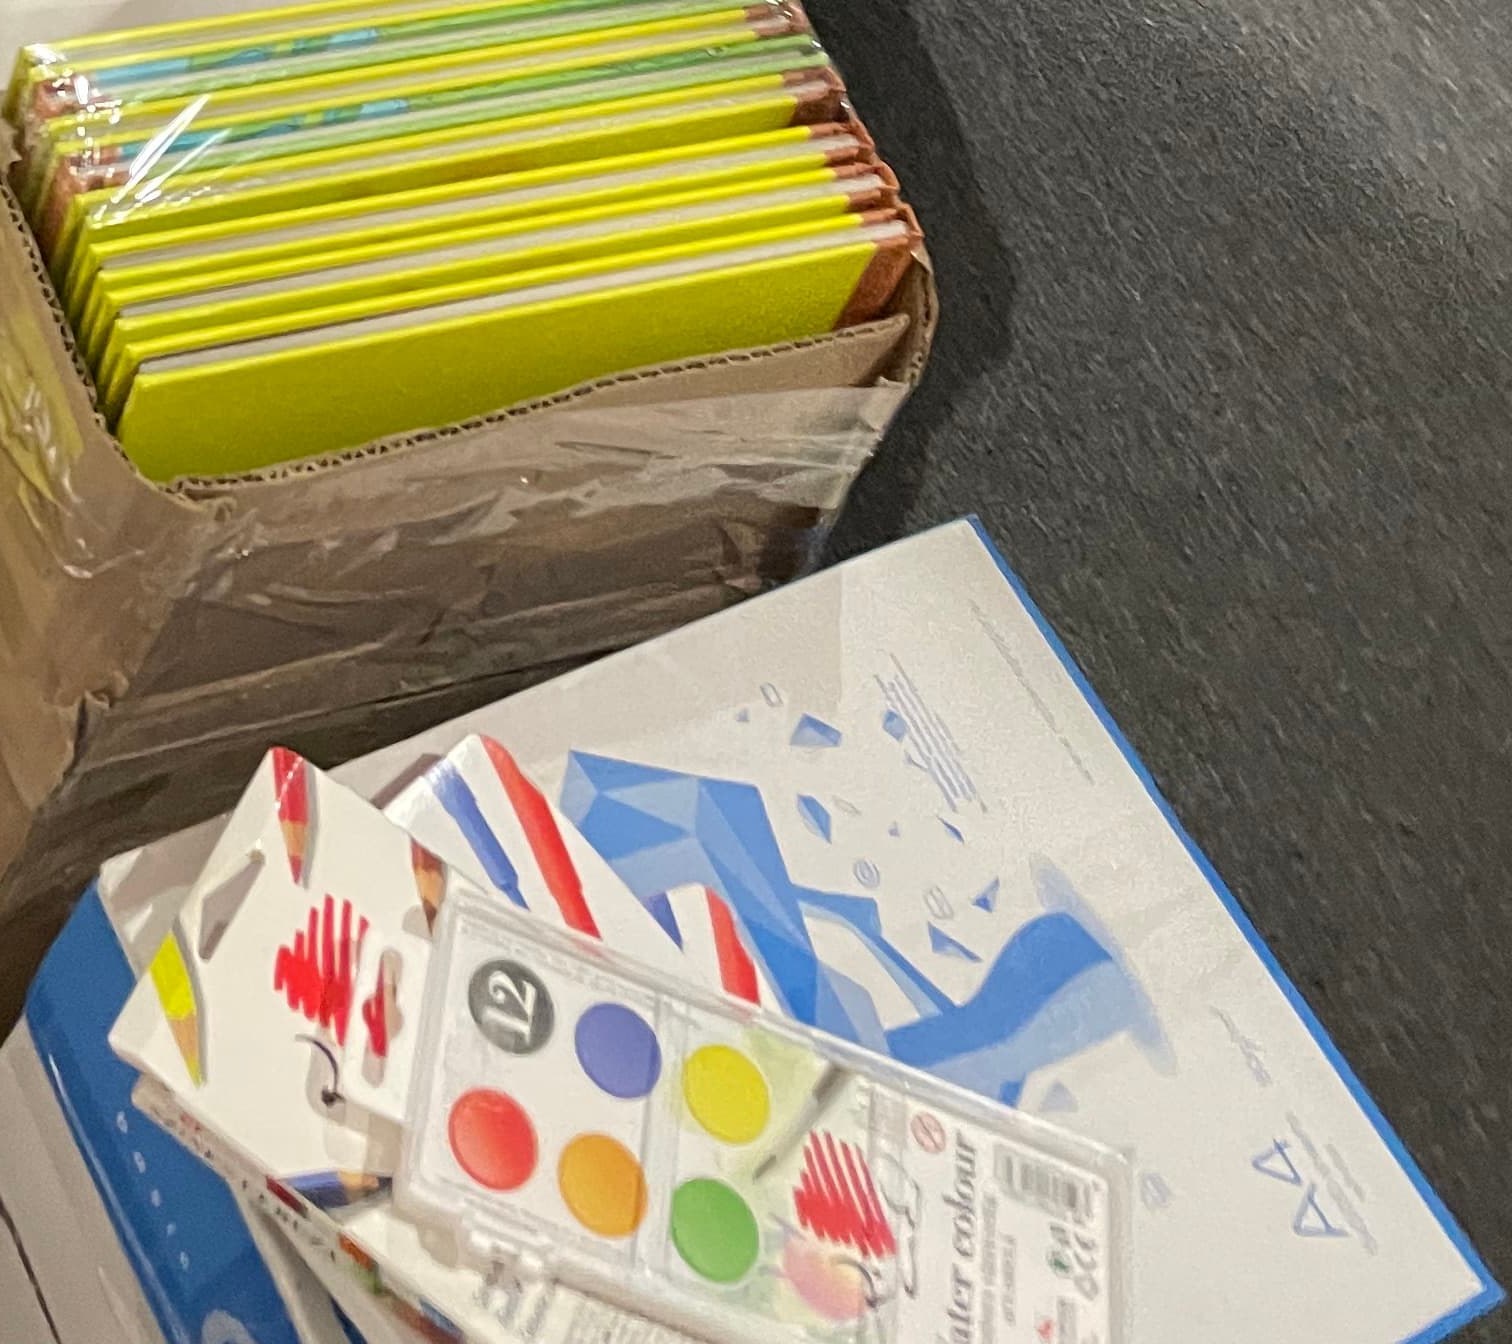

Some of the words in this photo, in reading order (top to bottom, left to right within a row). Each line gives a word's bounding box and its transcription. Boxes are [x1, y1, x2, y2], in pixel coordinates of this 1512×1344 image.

[488, 970, 539, 1042] 12
[941, 1128, 979, 1271] colour
[935, 1273, 977, 1344] ater
